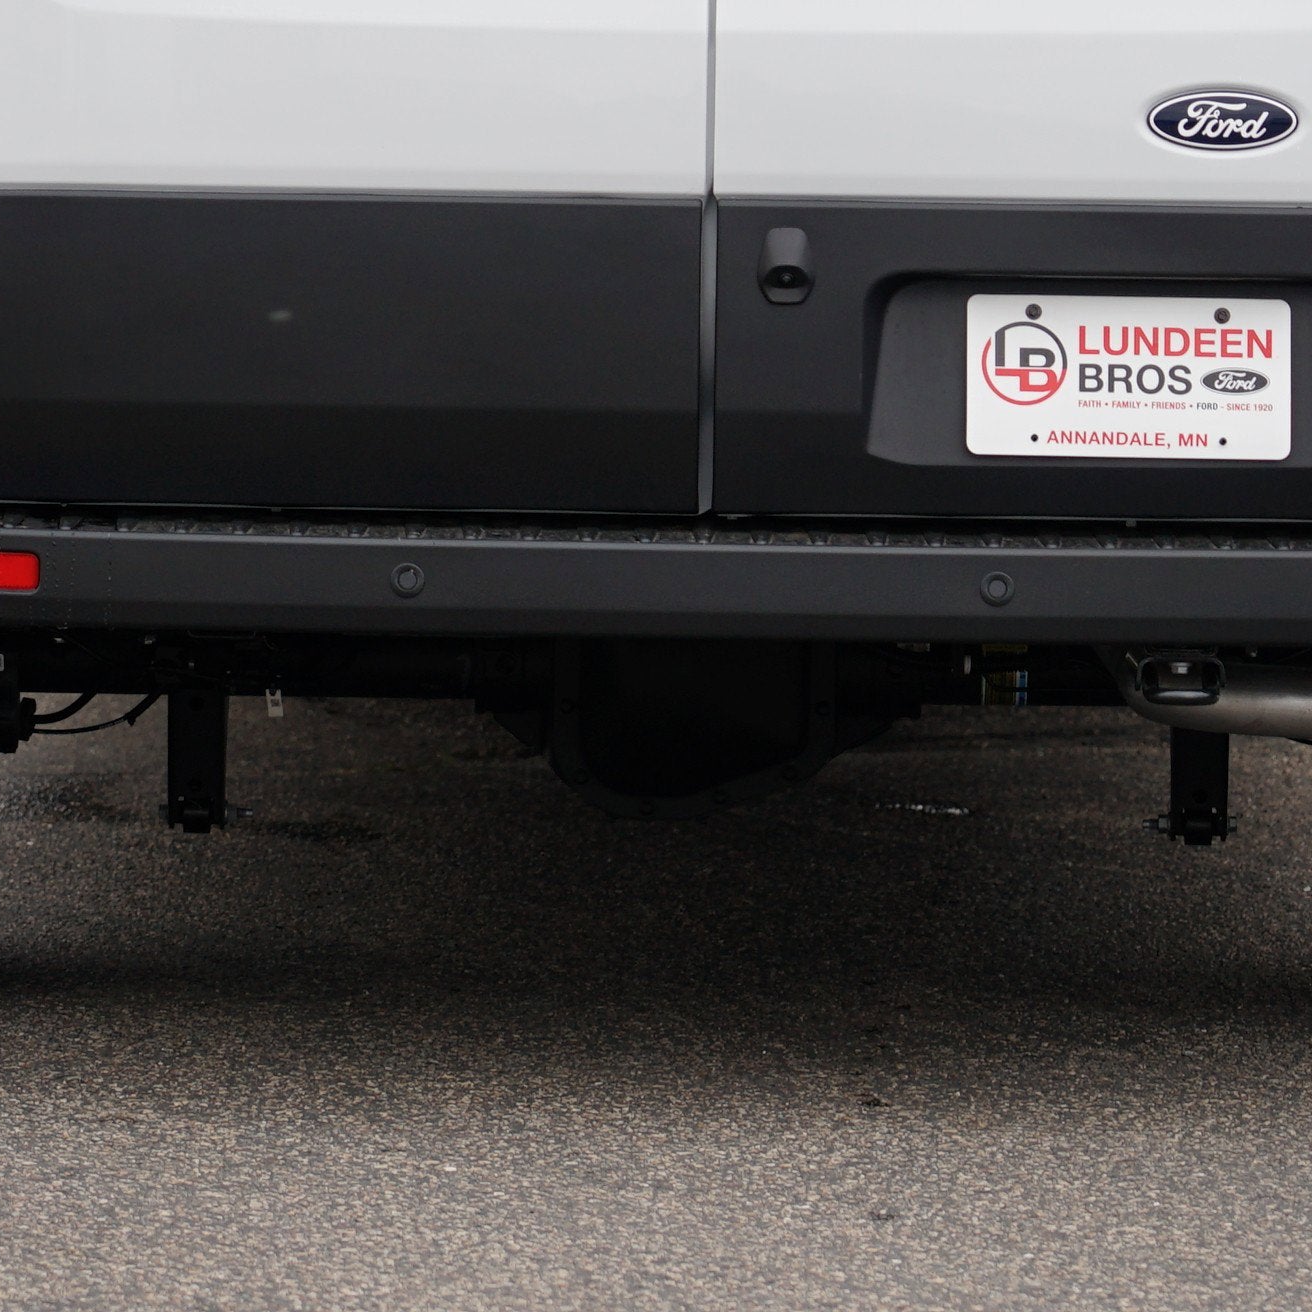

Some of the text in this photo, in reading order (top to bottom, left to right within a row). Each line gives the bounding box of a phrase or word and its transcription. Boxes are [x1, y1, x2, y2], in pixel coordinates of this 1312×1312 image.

[1177, 100, 1270, 139] Ford
[1078, 325, 1273, 359] LUNDEEN
[1078, 363, 1257, 395] BROS Ford
[1078, 399, 1273, 412] FAITH FAMILY FRIENDS FORD SINCE 1920
[1046, 430, 1208, 449] ANNANDALE, MN
